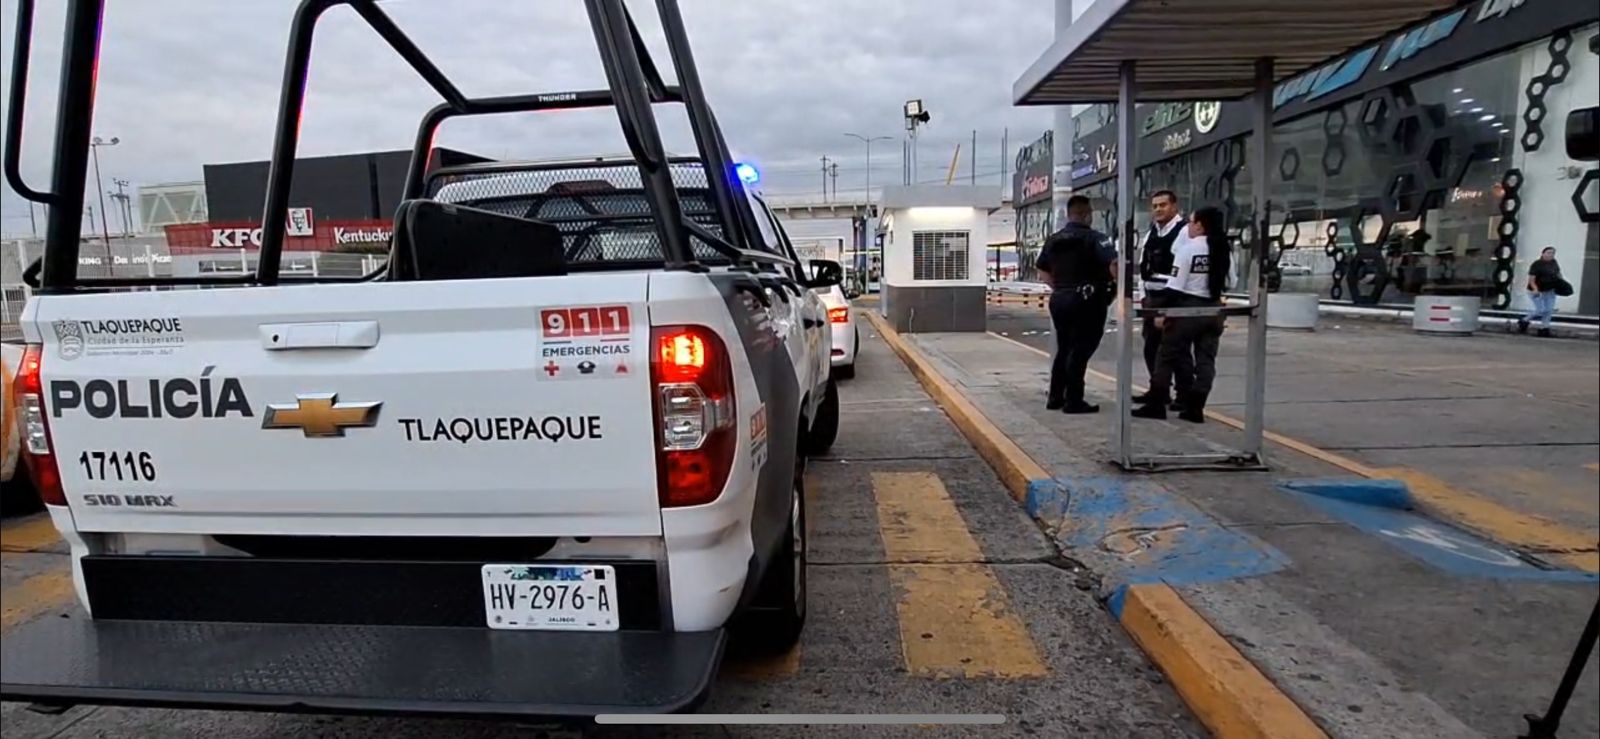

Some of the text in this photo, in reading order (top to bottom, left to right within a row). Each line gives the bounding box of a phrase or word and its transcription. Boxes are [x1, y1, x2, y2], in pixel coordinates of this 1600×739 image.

[538, 93, 577, 102] THUNDER
[80, 318, 182, 335] TLAQUEPAQUE
[547, 310, 621, 334] 911
[542, 345, 631, 357] EMERGENCIAS
[50, 365, 254, 419] POLICÍA
[398, 416, 603, 444] TLAQUEPAQUE
[79, 451, 156, 481] 17116
[490, 583, 610, 611] HV-2976-A
